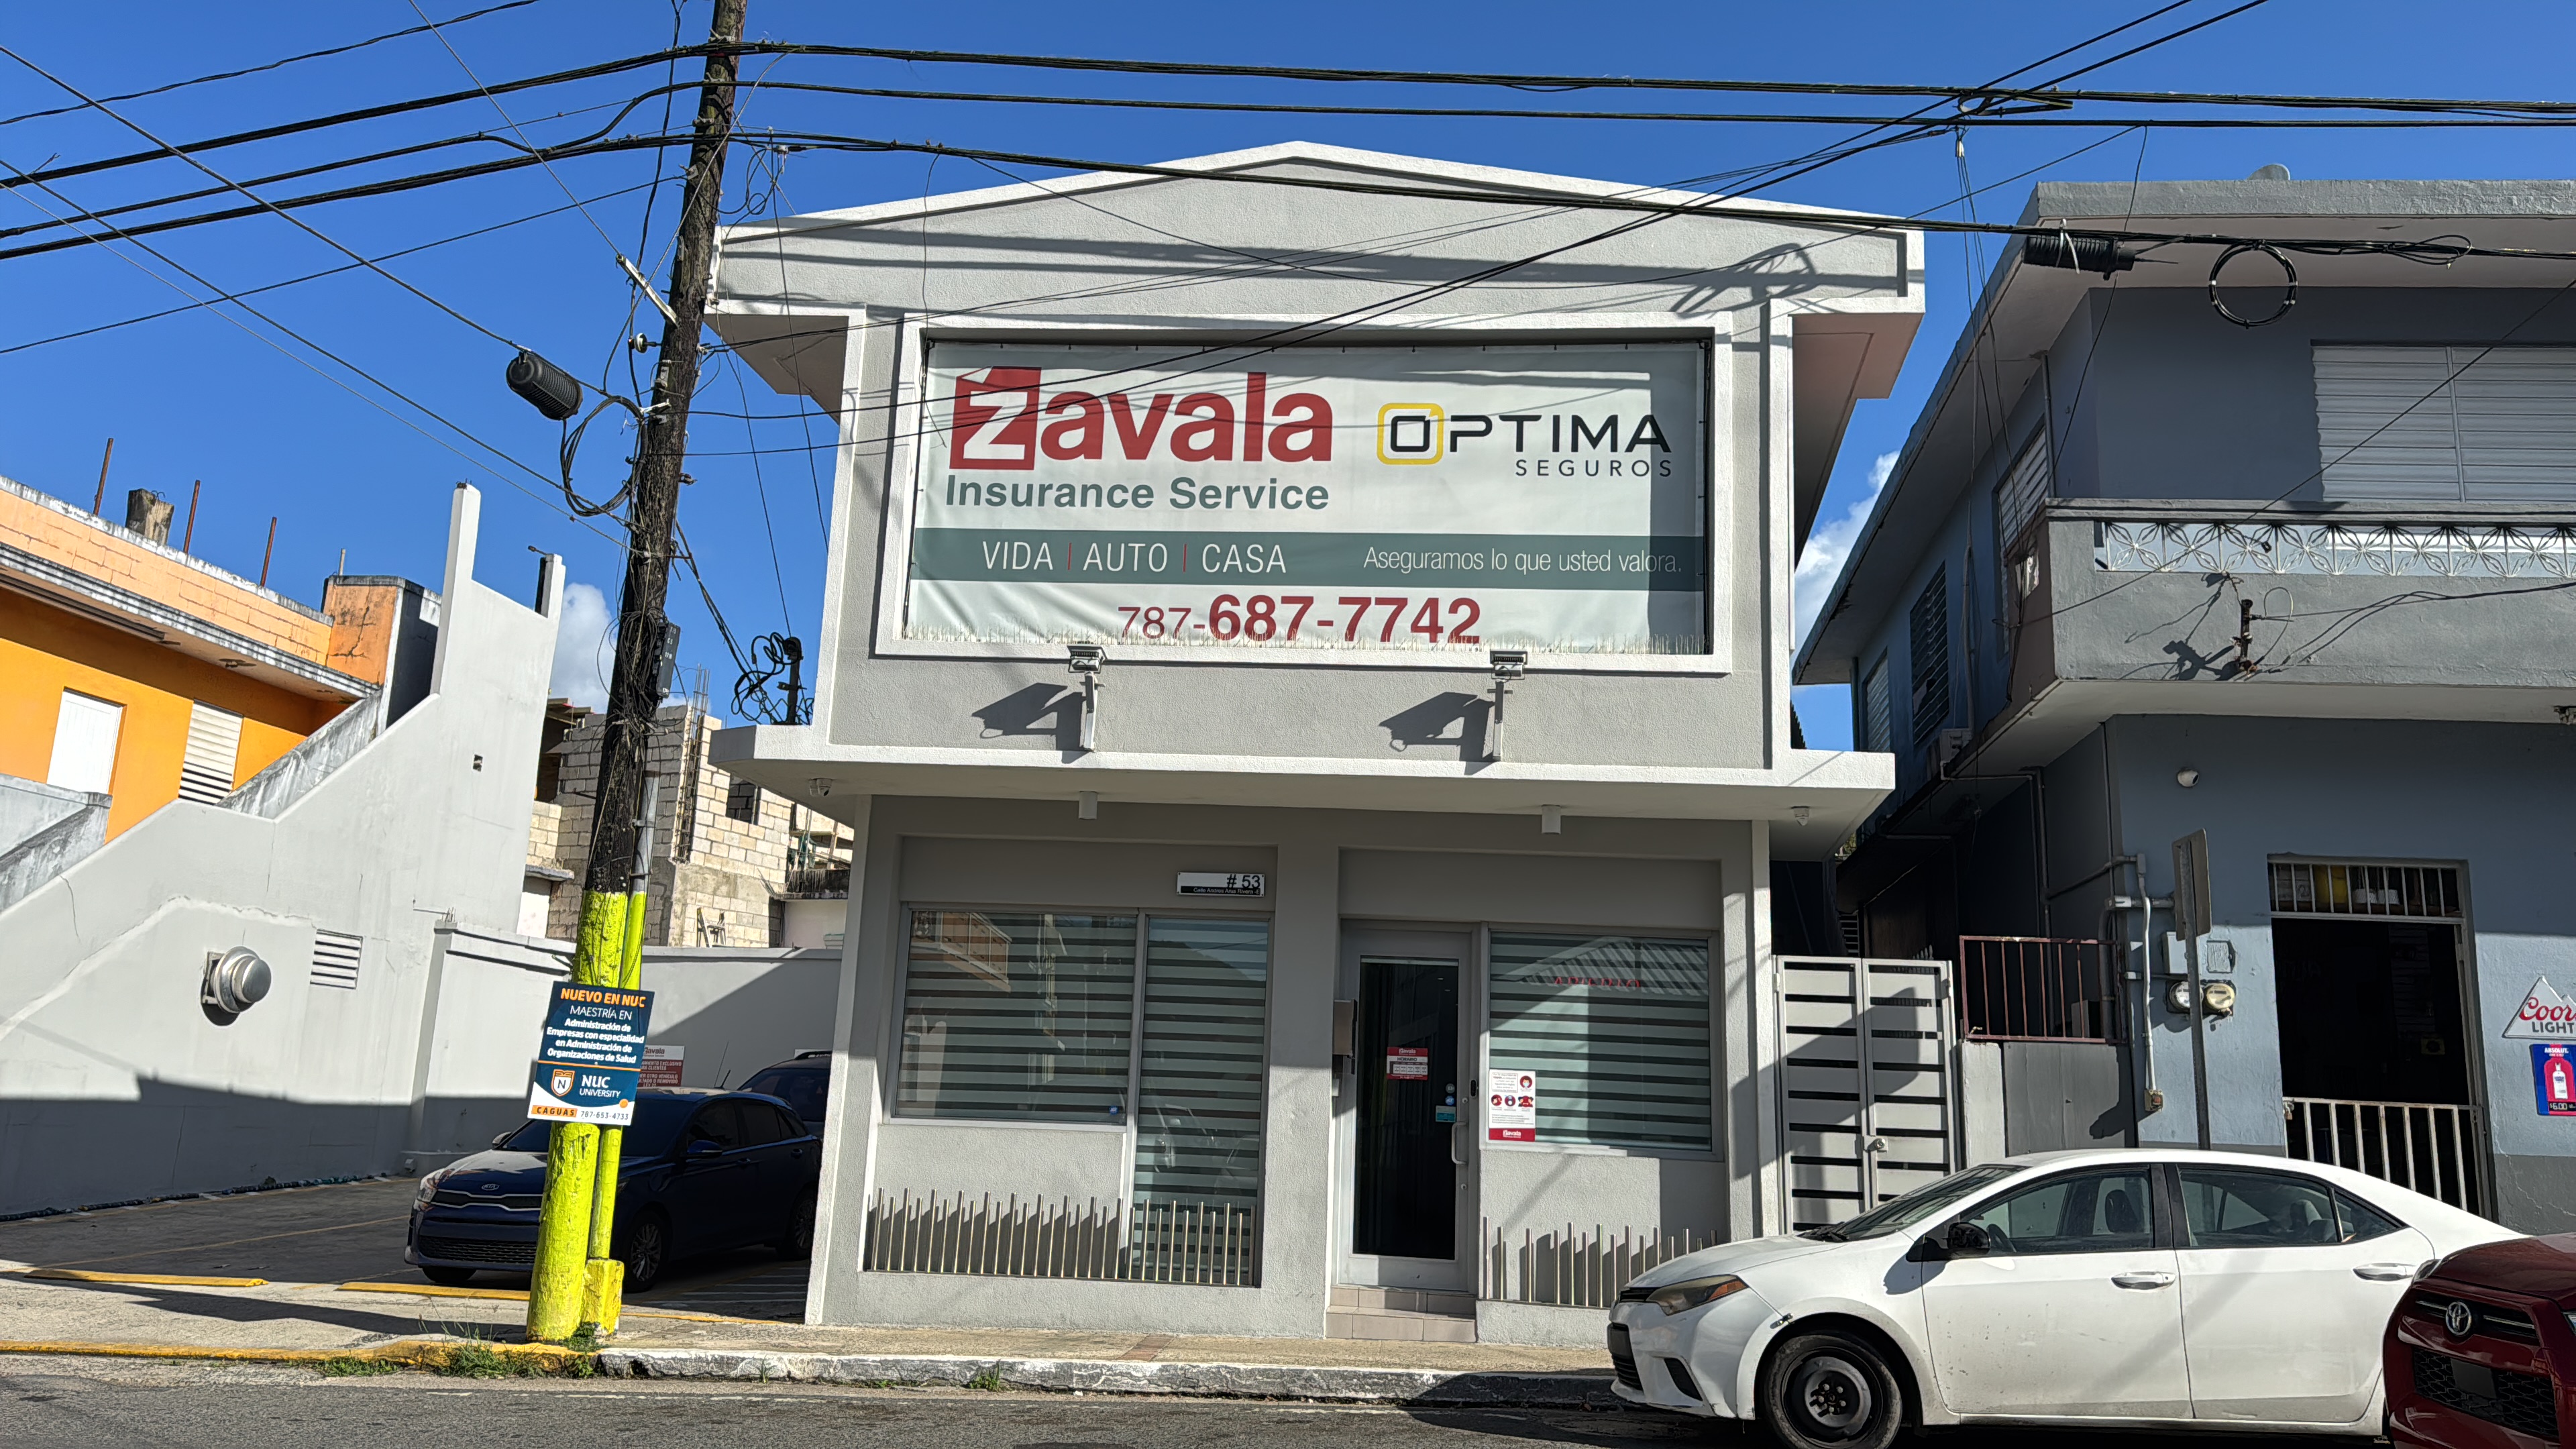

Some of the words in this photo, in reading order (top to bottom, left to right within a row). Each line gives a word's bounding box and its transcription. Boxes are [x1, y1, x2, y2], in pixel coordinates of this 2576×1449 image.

[949, 366, 1333, 470] Zavala
[1390, 413, 1672, 453] OPTIMA
[1515, 458, 1672, 478] SEGUROS
[946, 474, 1155, 508] Insurance
[1169, 476, 1329, 510] Service
[982, 540, 1053, 570] VIDA
[1082, 542, 1168, 572] AUTO
[1201, 543, 1287, 574] CASA
[1363, 546, 1484, 574] Aseguramos
[1491, 547, 1508, 570] lo
[1515, 552, 1552, 576] que
[1559, 549, 1611, 572] usted
[1618, 551, 1682, 573] valora.
[1117, 593, 1481, 645] 787-687-7742
[1241, 875, 1260, 889] 53
[560, 987, 602, 1004] NUEVO
[604, 992, 621, 1005] EN
[621, 994, 646, 1008] NUC
[570, 1005, 617, 1019] MAESTRÍA
[619, 1010, 633, 1020] EN
[2518, 996, 2576, 1022] Coor
[564, 1018, 621, 1032] Administración
[621, 1024, 631, 1032] de
[2531, 1021, 2575, 1034] LIGHT
[547, 1026, 584, 1038] Empresas
[598, 1033, 645, 1044] especialidad
[566, 1039, 622, 1052] Administración
[623, 1044, 633, 1053] de
[547, 1048, 604, 1061] Organizaciones
[605, 1053, 615, 1061] de
[616, 1054, 637, 1064] Salud
[581, 1075, 610, 1089] NUC
[579, 1088, 621, 1098] UNIVERSITY
[536, 1106, 575, 1116] CAGUAS
[580, 1110, 629, 1120] 787-653-4733
